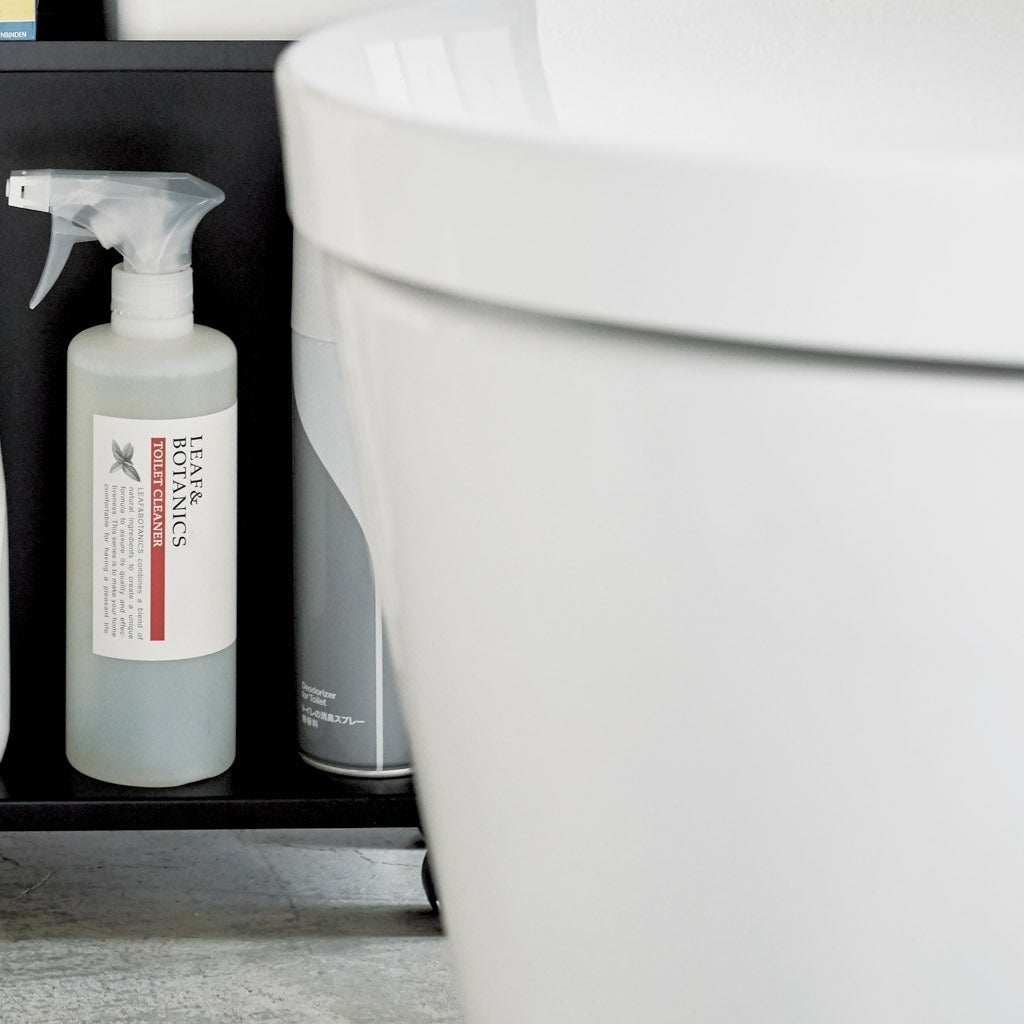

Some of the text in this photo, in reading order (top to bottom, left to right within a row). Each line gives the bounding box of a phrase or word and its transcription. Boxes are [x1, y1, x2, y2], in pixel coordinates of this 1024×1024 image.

[189, 434, 204, 506] LEAF&
[152, 441, 164, 548] TOILET CLEANER
[172, 437, 187, 548] BOTANICS
[127, 517, 135, 559] ingredients
[137, 487, 145, 554] LEAF&BOTANICS
[102, 547, 110, 572] having
[118, 570, 126, 595] quality
[137, 632, 143, 640] of
[309, 694, 327, 707] Toilet
